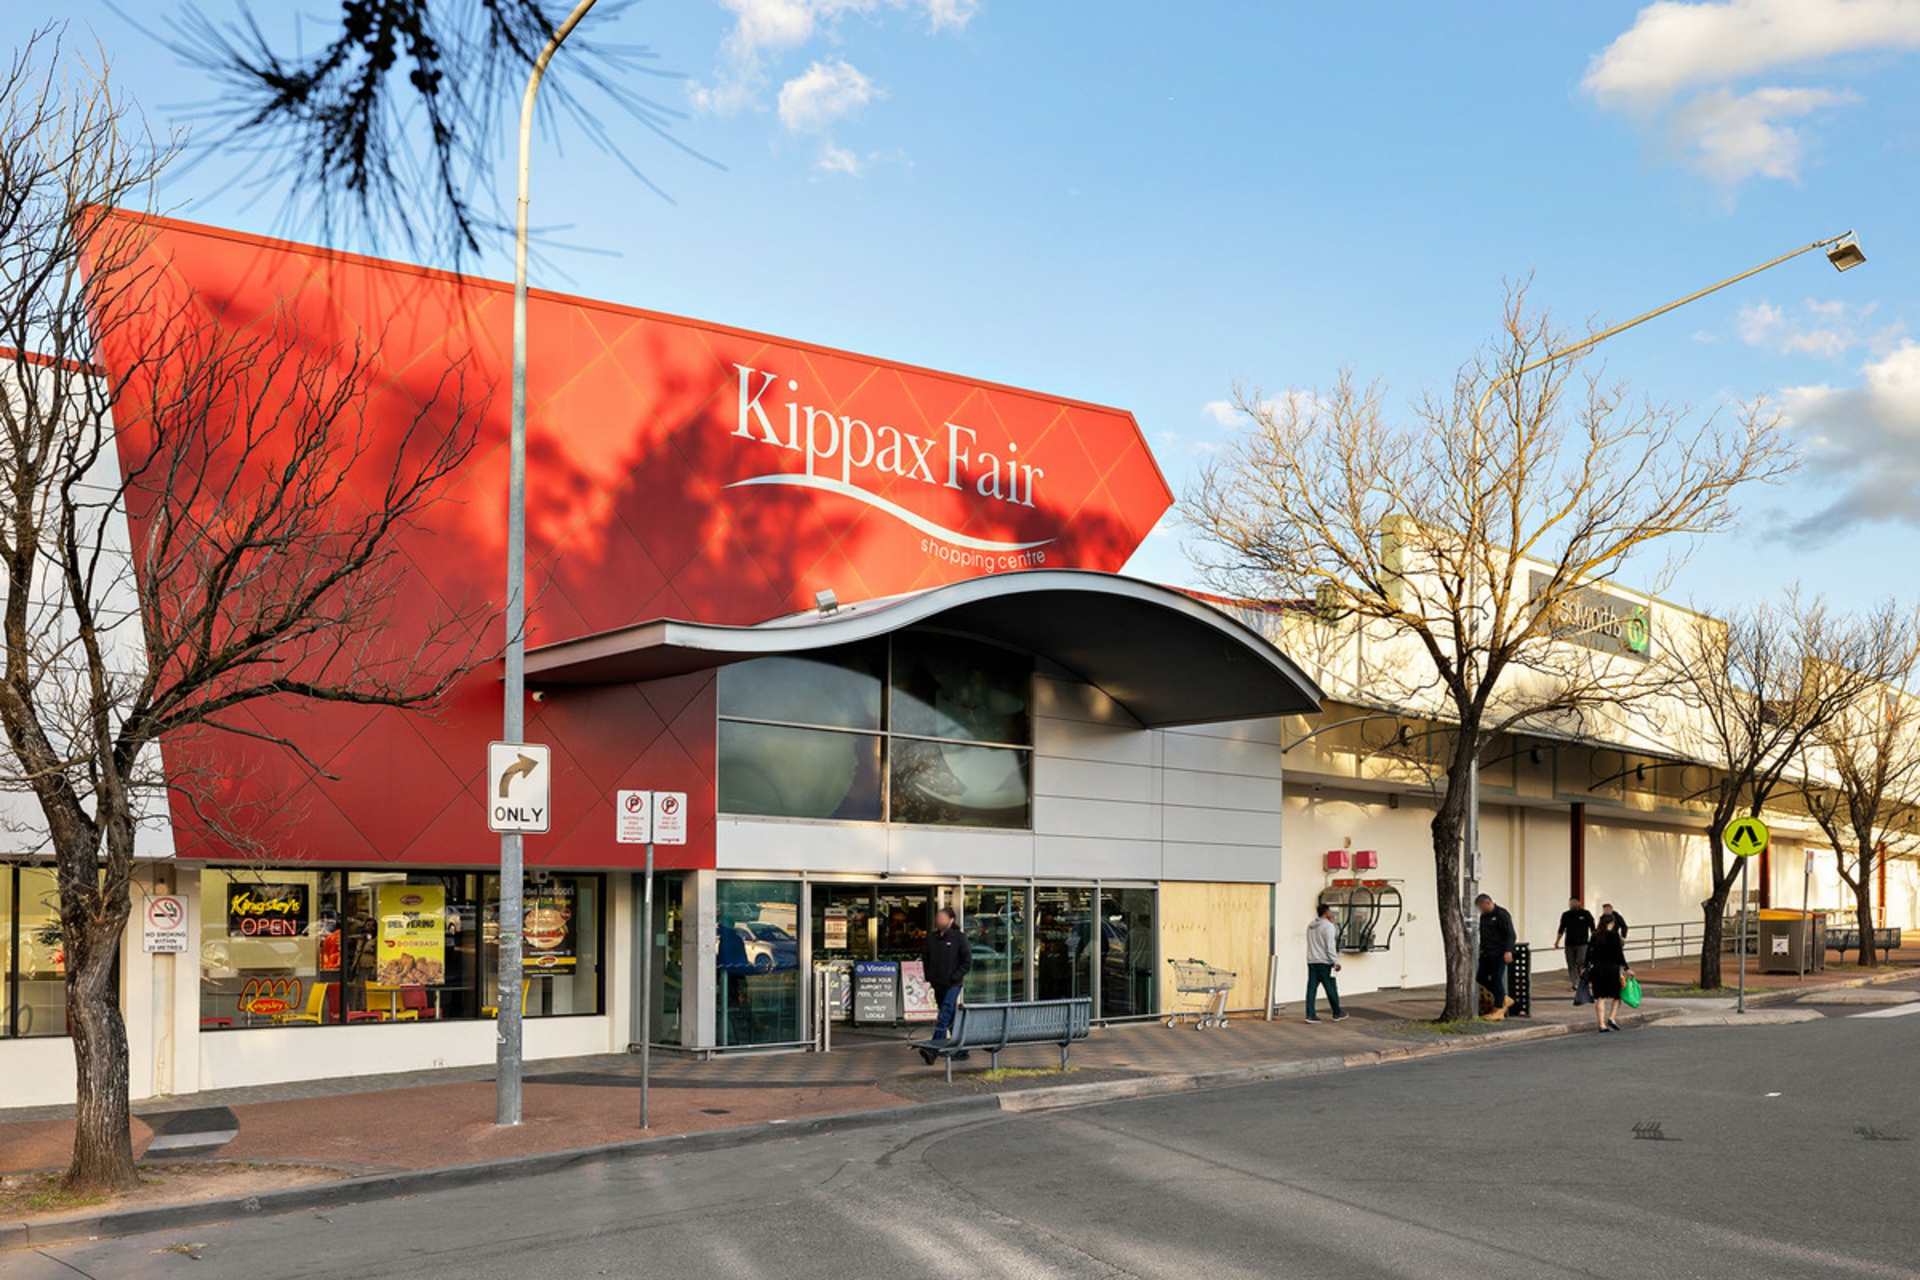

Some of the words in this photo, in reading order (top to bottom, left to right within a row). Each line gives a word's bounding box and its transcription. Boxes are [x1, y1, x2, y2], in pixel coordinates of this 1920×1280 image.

[731, 363, 936, 484] Kippax
[943, 421, 1044, 508] Fair
[921, 538, 994, 573] shopping
[998, 550, 1046, 569] centre
[494, 806, 543, 822] ONLY
[537, 883, 575, 896] Tandoori
[230, 892, 300, 915] Kingsley's
[240, 918, 297, 936] OPEN
[397, 940, 439, 948] DOORDASH
[866, 964, 896, 972] Vinnies
